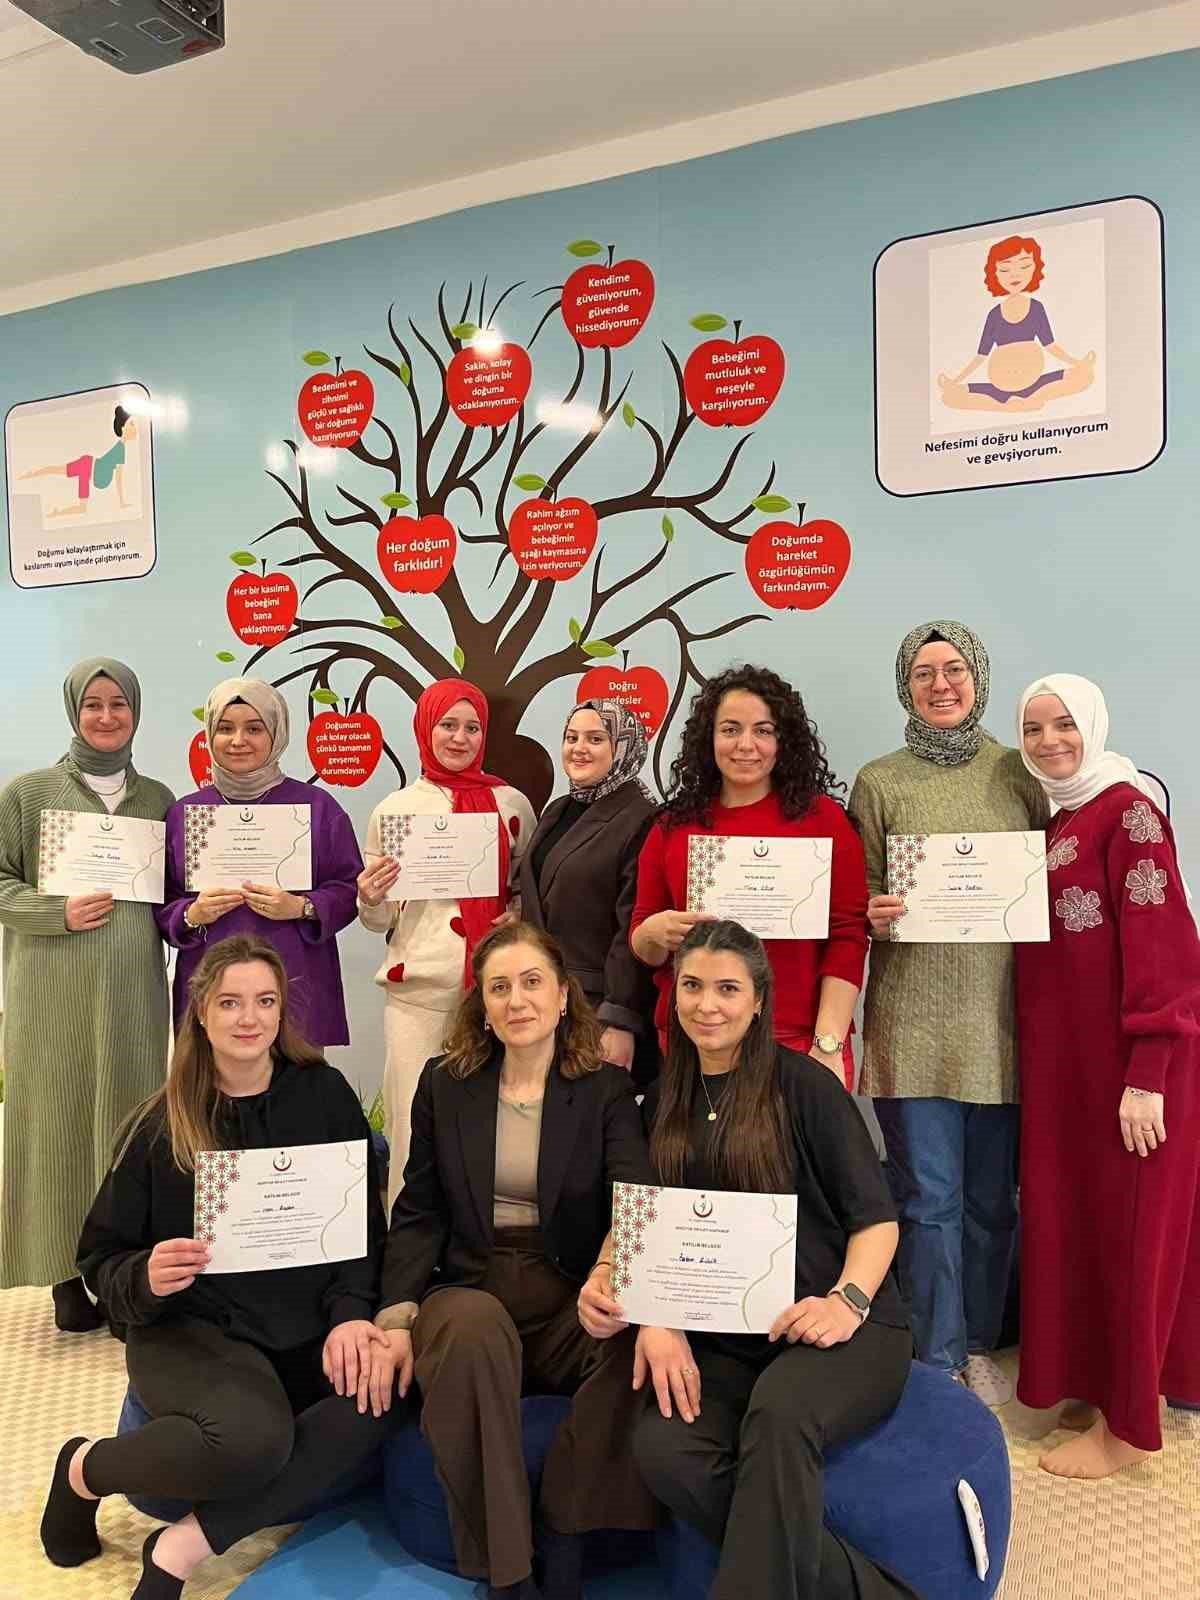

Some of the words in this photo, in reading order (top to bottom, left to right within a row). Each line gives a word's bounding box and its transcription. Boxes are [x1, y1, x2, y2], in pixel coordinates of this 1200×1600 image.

[588, 274, 630, 288] Kendime
[576, 288, 642, 305] güveniyorum,
[588, 303, 629, 319] güvende
[576, 317, 641, 334] hissediyorum.
[712, 349, 760, 364] Bebeğimi
[464, 360, 488, 371] Sakin,
[464, 373, 473, 383] ve
[475, 372, 500, 384] dingin
[502, 371, 512, 380] bir
[705, 366, 750, 381] mutluluk
[754, 366, 766, 374] ve
[312, 381, 346, 392] Bedenimi
[472, 386, 505, 398] doğuma
[716, 381, 755, 395] neşeyle
[322, 393, 348, 403] zihnimi
[701, 396, 768, 411] karşılıyorum.
[458, 398, 518, 411] odaklanıyorum.
[327, 418, 357, 427] doğuma
[925, 437, 978, 453] Nefesimi
[981, 432, 1018, 445] doğru
[1022, 422, 1109, 441] kullanıyorum
[967, 455, 981, 464] ve
[984, 446, 1062, 464] gevşiyorum.
[527, 508, 554, 519] Rahim
[556, 506, 580, 519] ağzım
[532, 521, 561, 532] açılıyor
[563, 521, 574, 529] ve
[531, 533, 575, 545] bebeğimin
[771, 533, 823, 548] Doğumda
[386, 541, 407, 553] Her
[410, 538, 449, 552] doğum
[543, 546, 586, 558] kaymasına
[776, 549, 817, 561] hareket
[394, 558, 443, 572] farklıdır!
[522, 561, 536, 571] izin
[539, 559, 583, 569] veriyorum.
[759, 564, 835, 578] özgürlüğümün
[234, 587, 247, 595] Her
[249, 586, 259, 594] bir
[261, 583, 289, 593] kasılma
[762, 581, 829, 594] farkındayım.
[245, 598, 279, 609] bebeğimi
[253, 612, 272, 620] bana
[608, 681, 637, 692] Doğru
[608, 696, 642, 704] efesler
[325, 722, 361, 730] Doğumum
[316, 733, 328, 742] çok
[329, 733, 347, 743] kolay
[322, 768, 367, 776] durumdayım.
